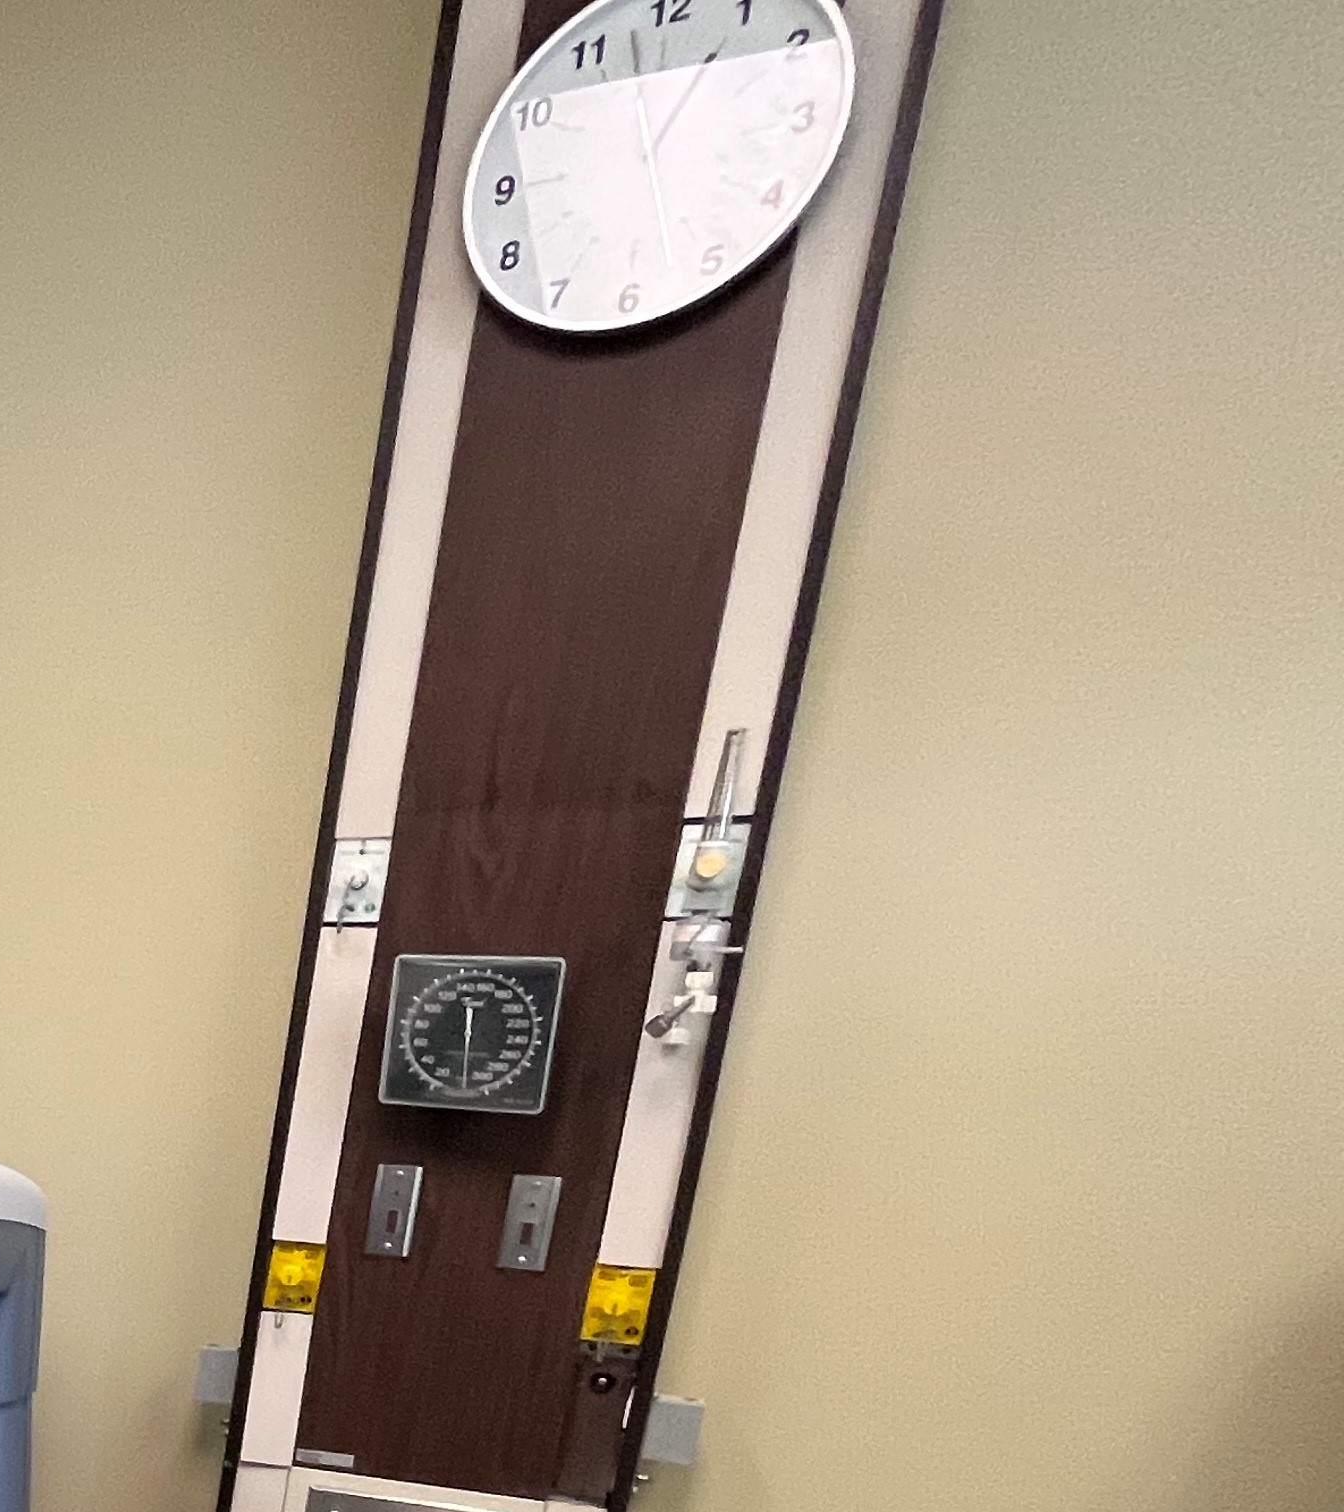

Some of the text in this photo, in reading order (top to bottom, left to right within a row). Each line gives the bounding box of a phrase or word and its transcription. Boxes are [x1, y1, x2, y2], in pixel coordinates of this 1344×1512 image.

[651, 0, 691, 27] 12
[736, 0, 753, 25] 1
[571, 33, 608, 70] 11
[785, 28, 811, 61] 2
[515, 96, 554, 132] 10
[790, 100, 816, 134] 3
[493, 174, 517, 207] 9
[760, 178, 786, 211] 4
[498, 239, 521, 272] 8
[700, 243, 725, 277] 5
[549, 277, 572, 311] 7
[617, 282, 642, 314] 6
[501, 1002, 524, 1014] 200
[506, 1018, 530, 1029] 220
[506, 1034, 529, 1044] 240
[420, 1055, 435, 1065] 40
[434, 1066, 450, 1078] 20
